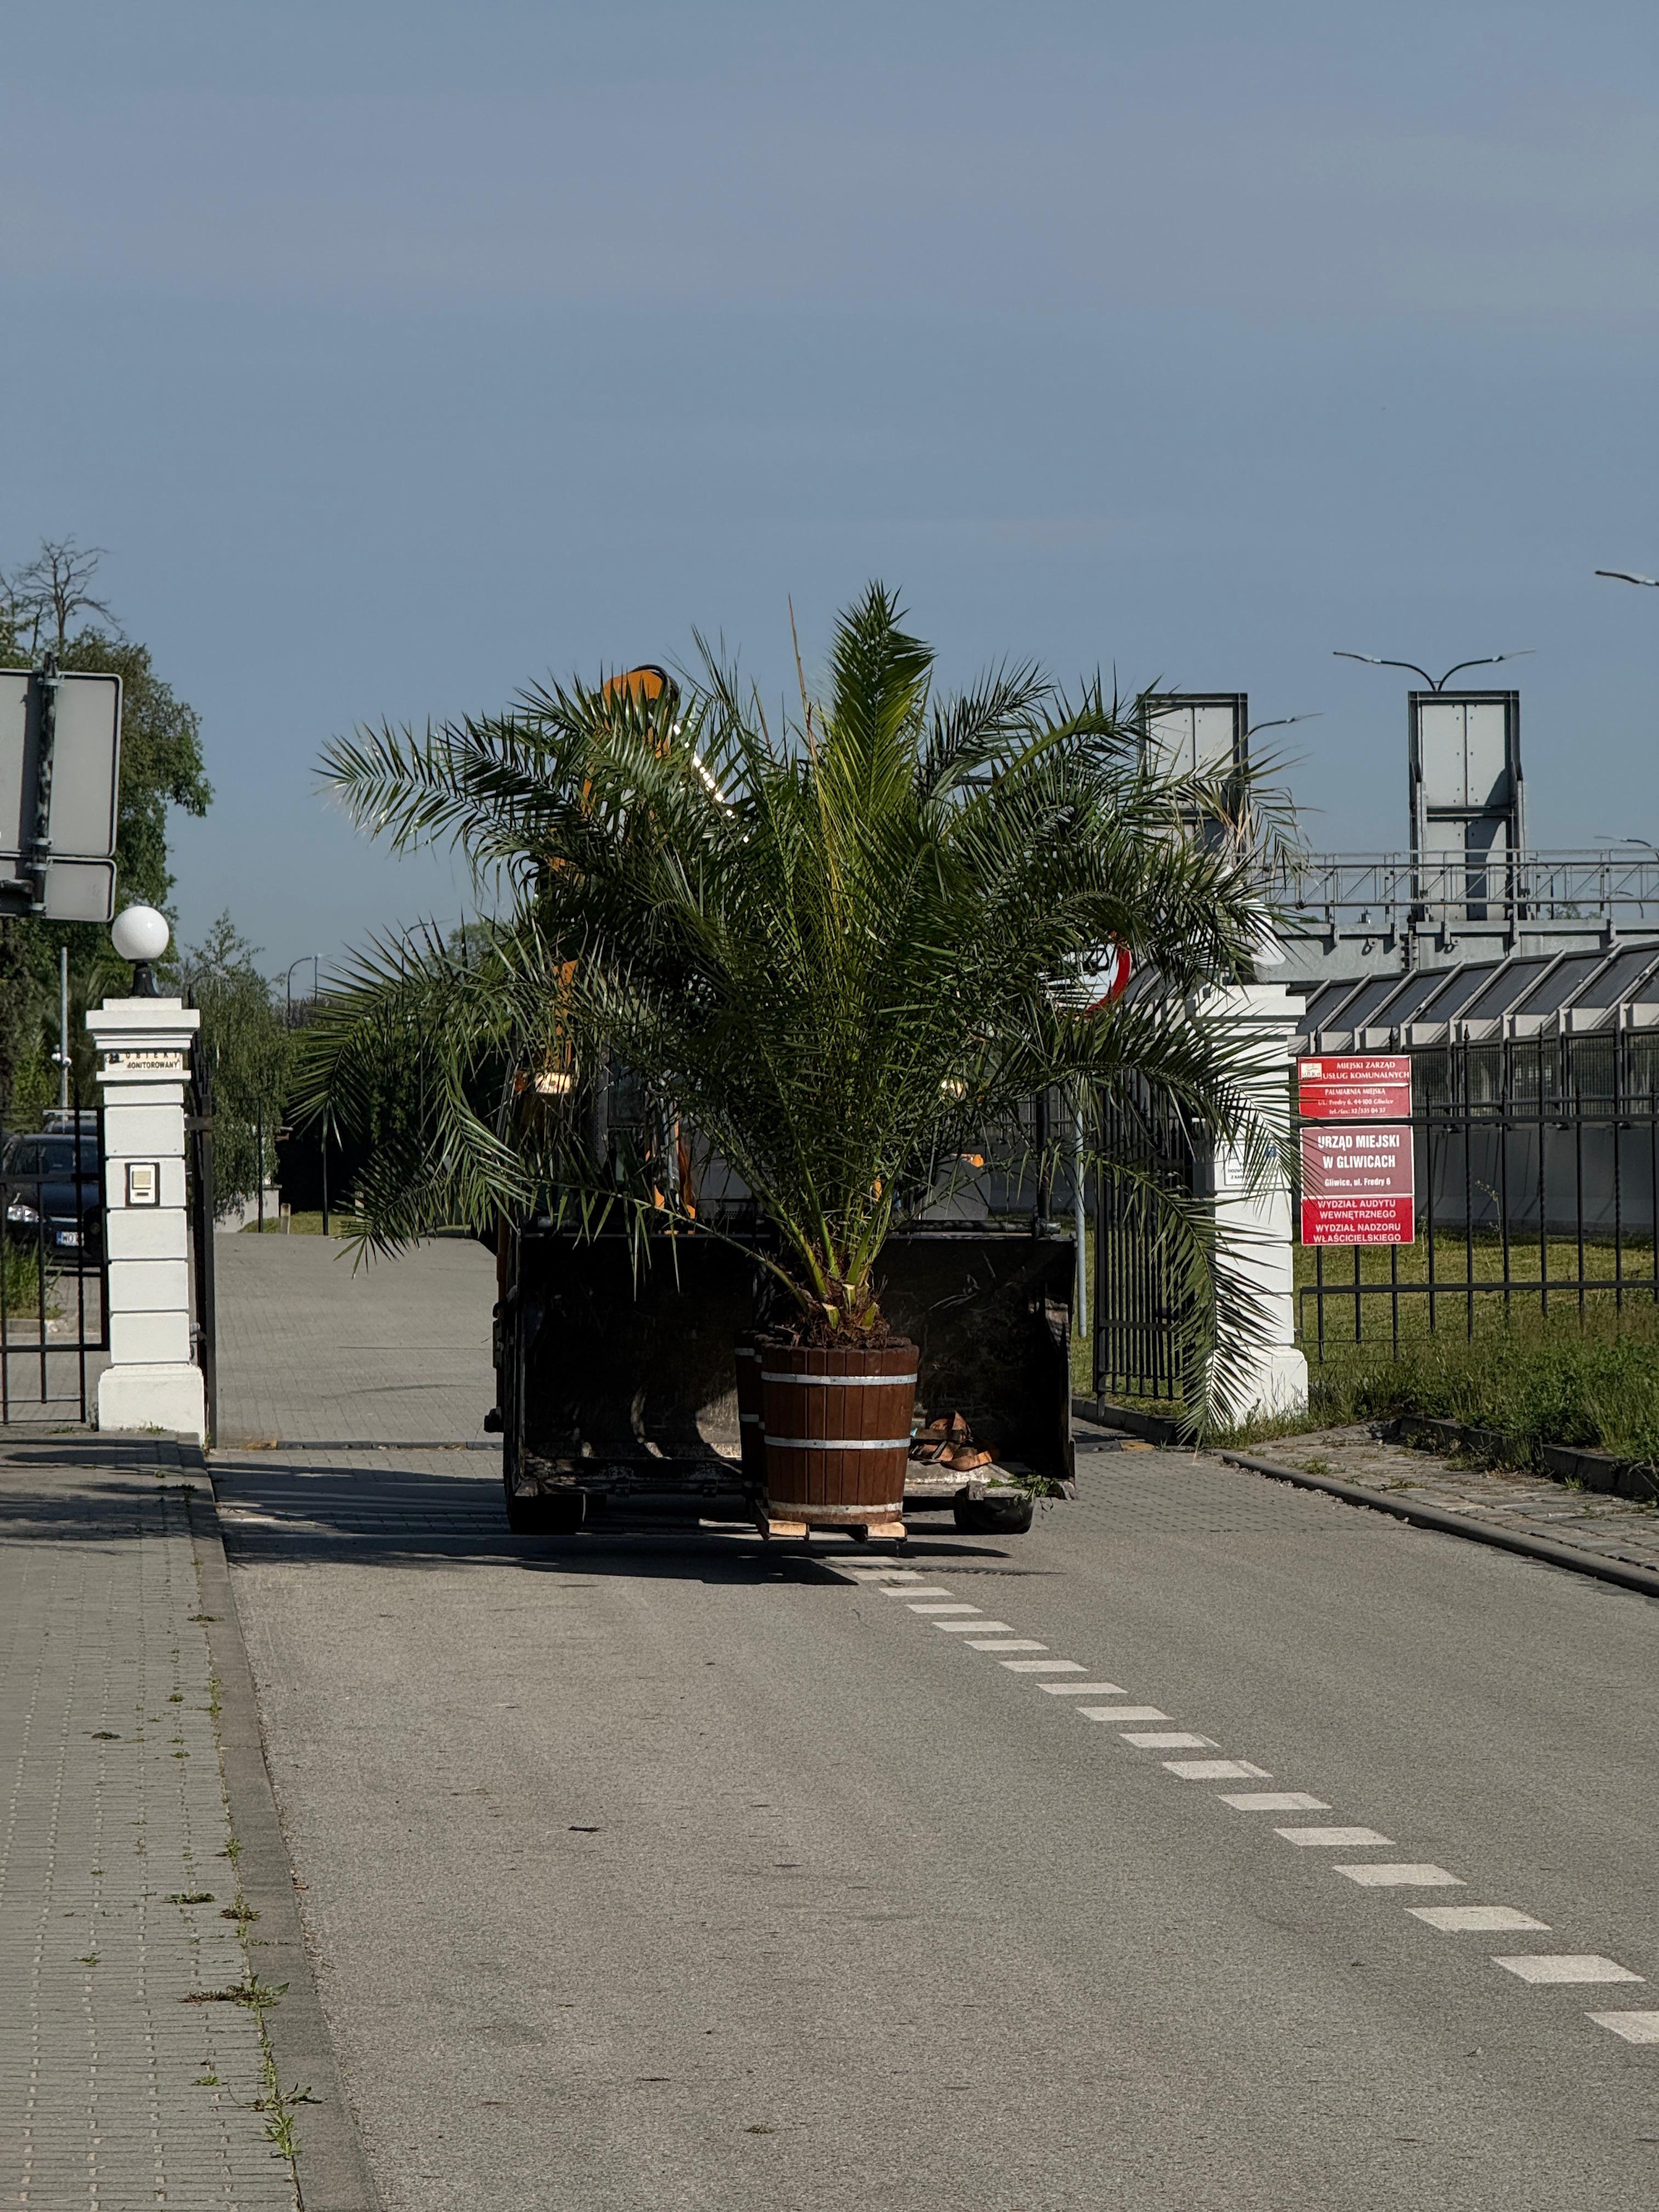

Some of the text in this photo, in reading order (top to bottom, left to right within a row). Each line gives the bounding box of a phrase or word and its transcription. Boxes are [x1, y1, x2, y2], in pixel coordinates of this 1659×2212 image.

[1336, 1062, 1396, 1070] MIEJSKI ZARZĄD
[1350, 1071, 1409, 1080] KOMUNALNYCH
[1362, 1087, 1386, 1096] MIEJSKA
[1317, 1135, 1400, 1150] URZĄD MIEJSKI
[1323, 1155, 1396, 1169] W GLIWICACH
[1324, 1179, 1353, 1187] Gliwice,
[1364, 1178, 1384, 1186] Fredry
[1317, 1199, 1396, 1208] WYDZIAŁ AUDYTU
[1320, 1210, 1396, 1220] WEWNĘTRZNEGO
[1316, 1223, 1401, 1232] WYDZIAŁ NADZORU
[1313, 1233, 1402, 1243] WŁAŚCICIELSKIEGO
